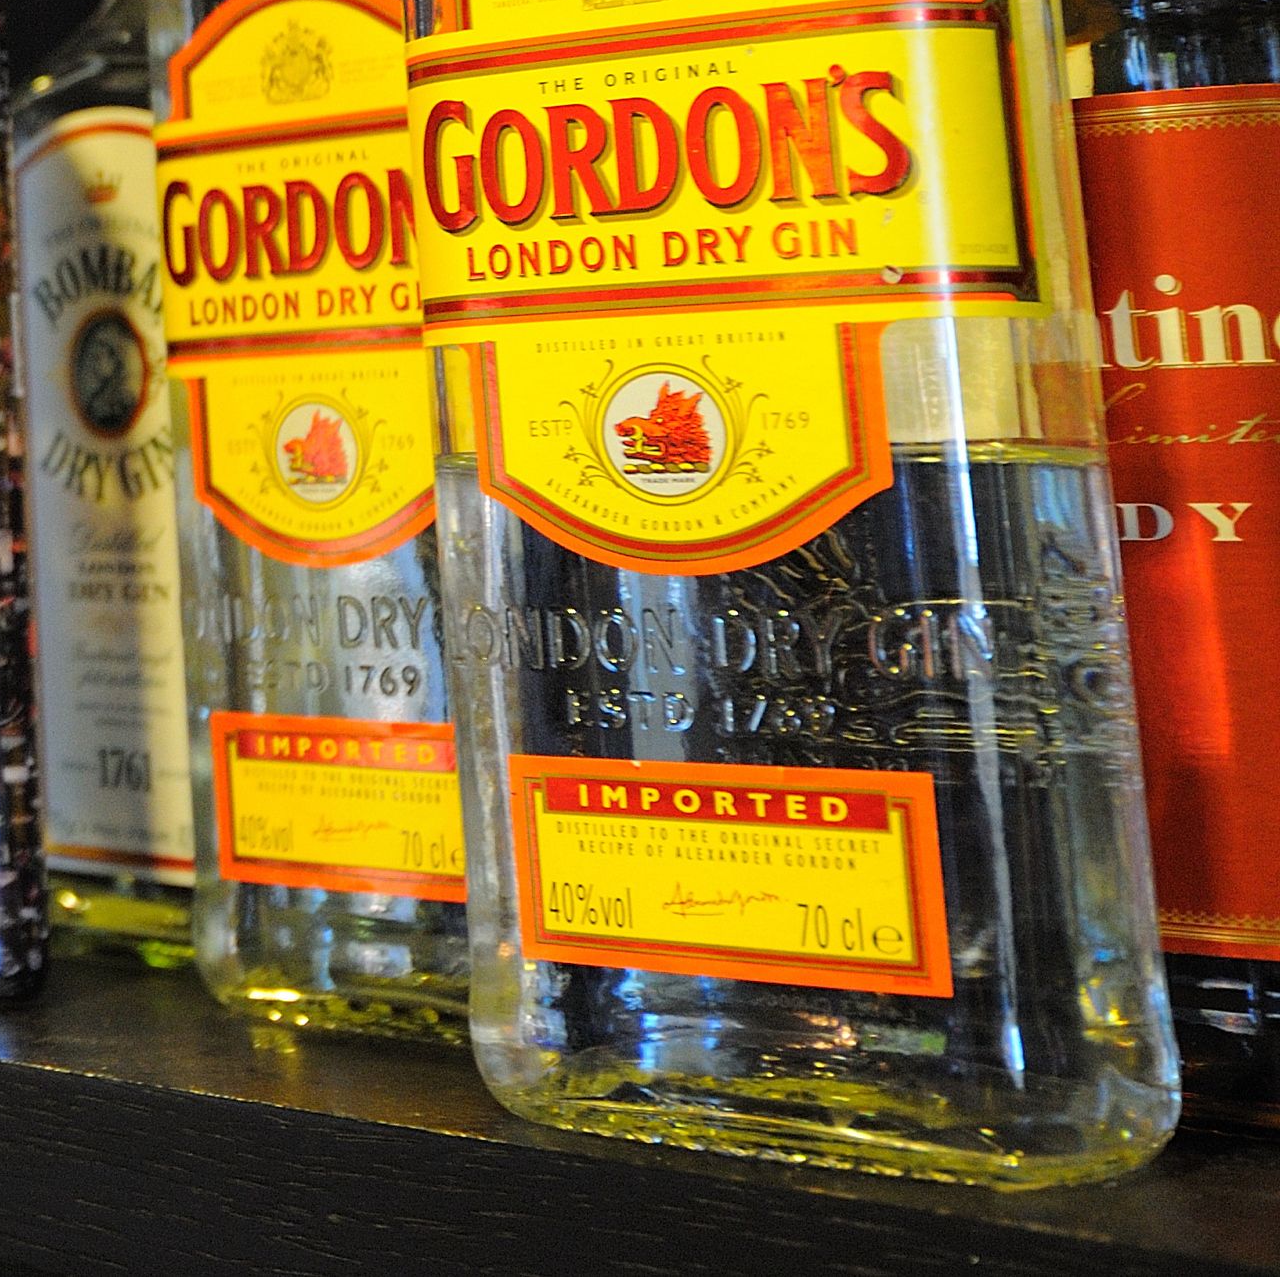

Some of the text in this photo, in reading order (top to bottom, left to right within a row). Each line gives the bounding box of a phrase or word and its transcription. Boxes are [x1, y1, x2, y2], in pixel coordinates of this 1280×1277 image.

[538, 61, 739, 95] THE ORIGINAL
[237, 148, 370, 174] THE ORIGINAL
[424, 64, 913, 234] GORDON'S
[467, 217, 860, 283] LONDON DRY GIN
[34, 244, 164, 321] BOMBA
[189, 282, 423, 327] LONDON DRY GI
[536, 330, 786, 354] DISTILLED IN GREAT BRITAIN
[760, 411, 810, 431] 1769
[546, 477, 630, 527] ALEXANDER
[639, 518, 704, 533] GORDON
[733, 475, 798, 521] COMPANY
[337, 595, 428, 650] DRY
[344, 665, 421, 697] 1769
[255, 736, 437, 764] IMPORTED
[577, 783, 850, 823] IMPORTED
[556, 820, 882, 855] DISTILLED TO THE ORIGINAL SECRET
[578, 840, 858, 871] RECIPE OF ALEXANDER GORDON
[548, 881, 635, 929] 40%vol
[797, 902, 830, 949] 70
